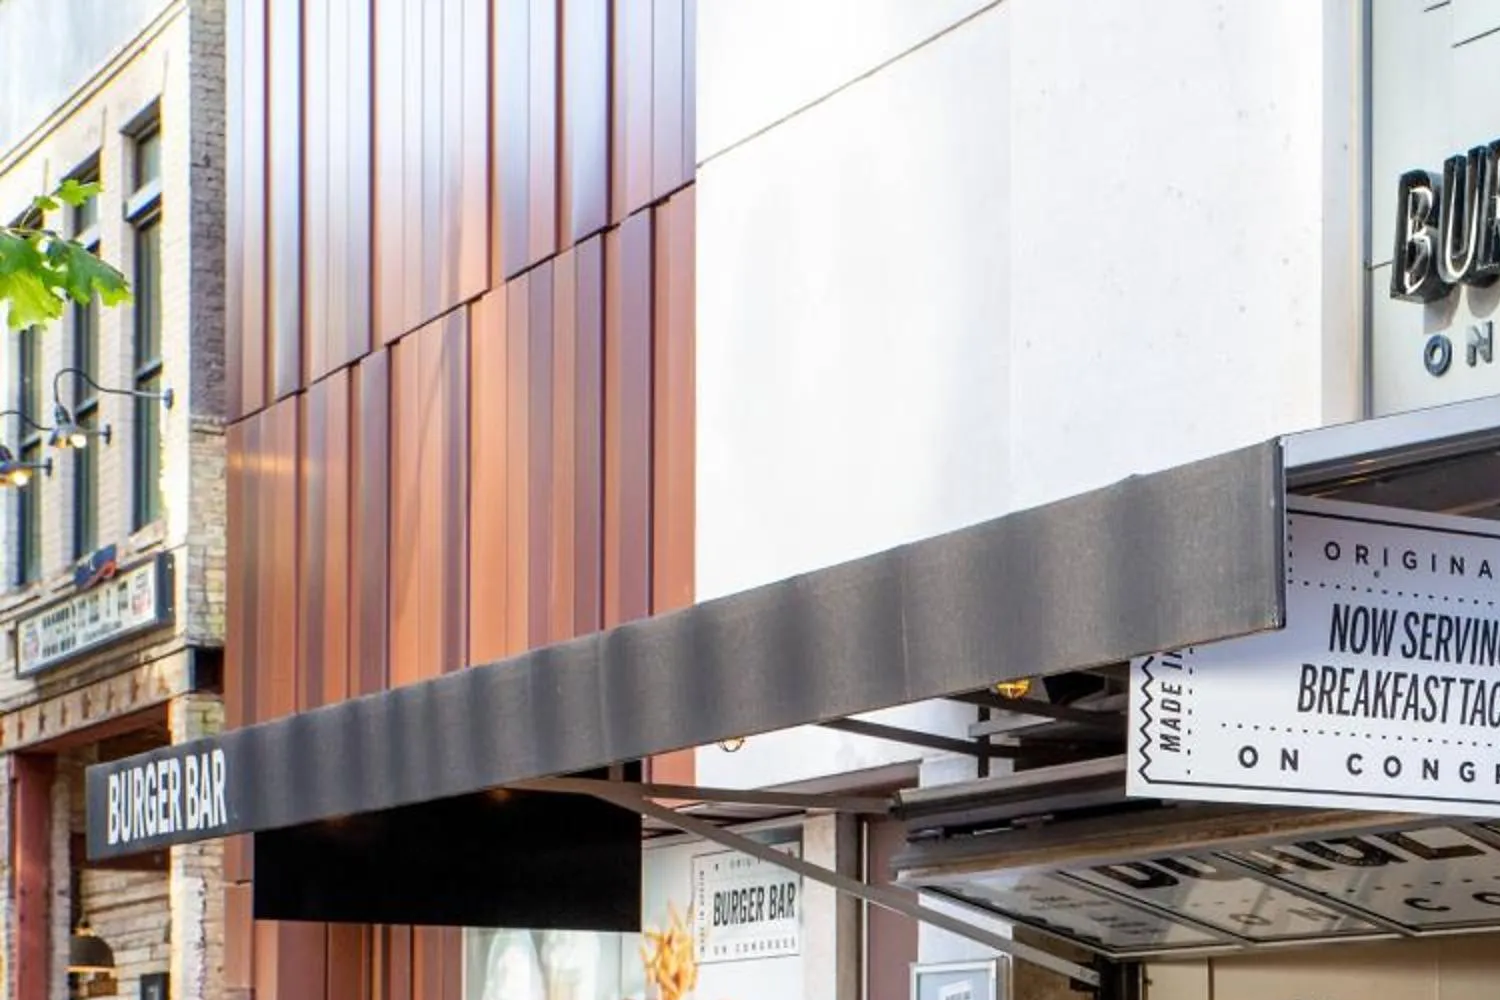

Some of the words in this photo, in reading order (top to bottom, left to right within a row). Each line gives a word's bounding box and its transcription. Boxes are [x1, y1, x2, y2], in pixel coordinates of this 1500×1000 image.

[1423, 320, 1492, 377] ON
[1329, 604, 1400, 658] NOW
[1161, 651, 1182, 670] I
[1160, 682, 1182, 753] MADE
[1297, 664, 1457, 725] BREAKFAST
[1239, 745, 1299, 772] ON
[107, 757, 183, 845] BURGER
[185, 748, 227, 831] BAR
[713, 885, 765, 926] BURGER
[768, 881, 796, 921] BAR
